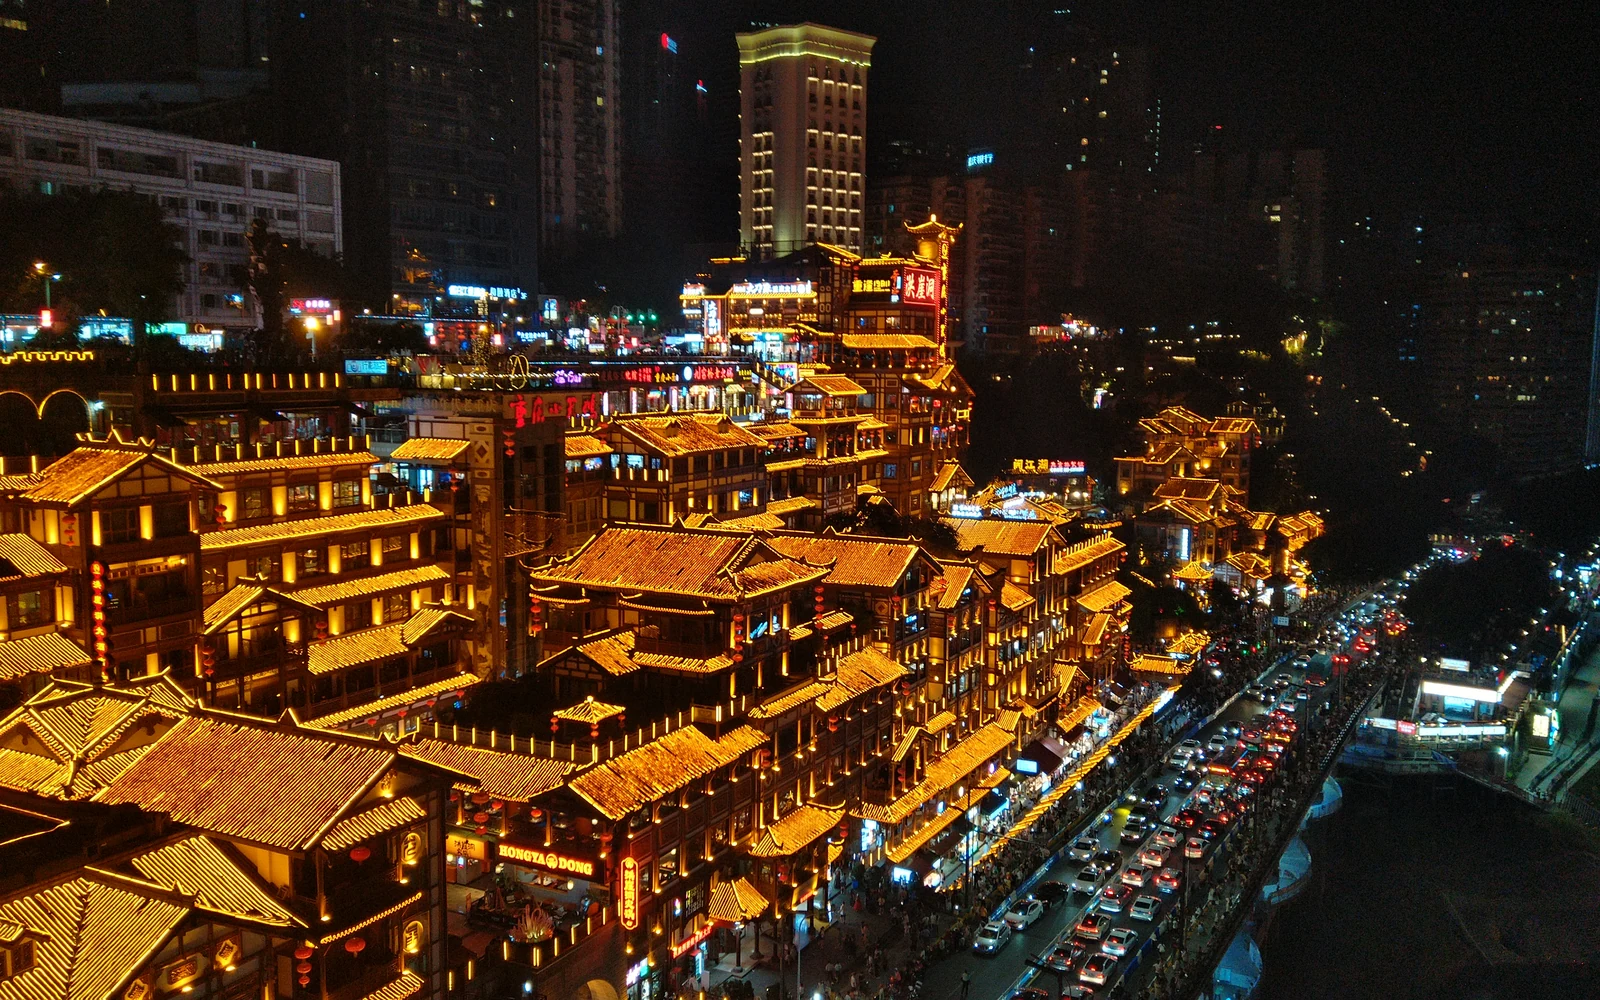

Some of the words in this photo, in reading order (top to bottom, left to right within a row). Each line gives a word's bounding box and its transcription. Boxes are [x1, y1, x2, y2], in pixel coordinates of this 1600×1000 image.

[905, 272, 936, 301] 洪崖洞
[499, 845, 546, 865] HONGYA
[558, 857, 593, 876] DONG
